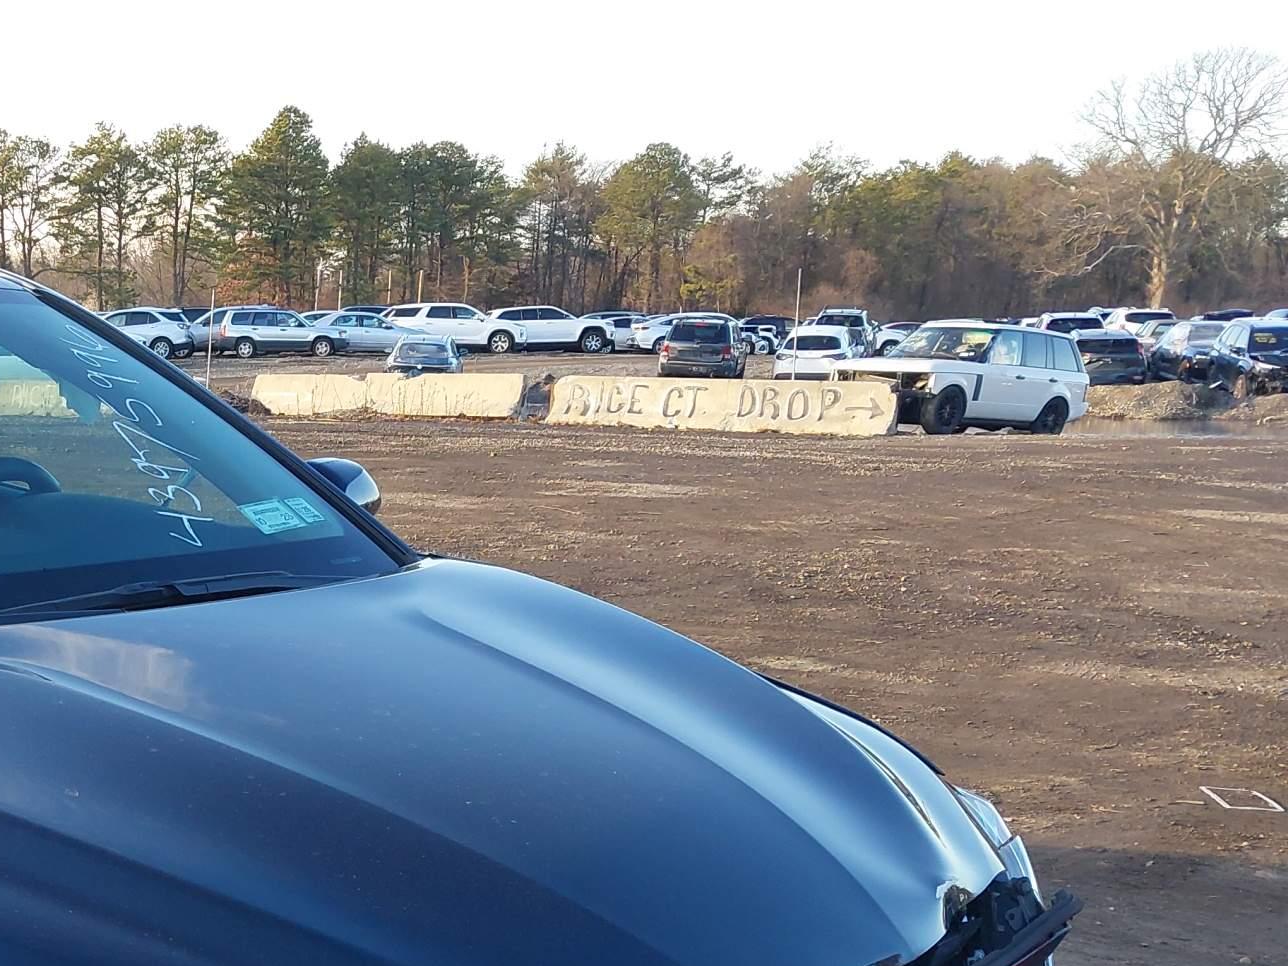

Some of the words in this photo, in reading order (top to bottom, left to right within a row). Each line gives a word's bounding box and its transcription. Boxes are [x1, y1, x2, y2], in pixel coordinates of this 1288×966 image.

[59, 324, 213, 547] 43975996
[563, 380, 650, 417] RICE
[736, 384, 842, 421] DROP
